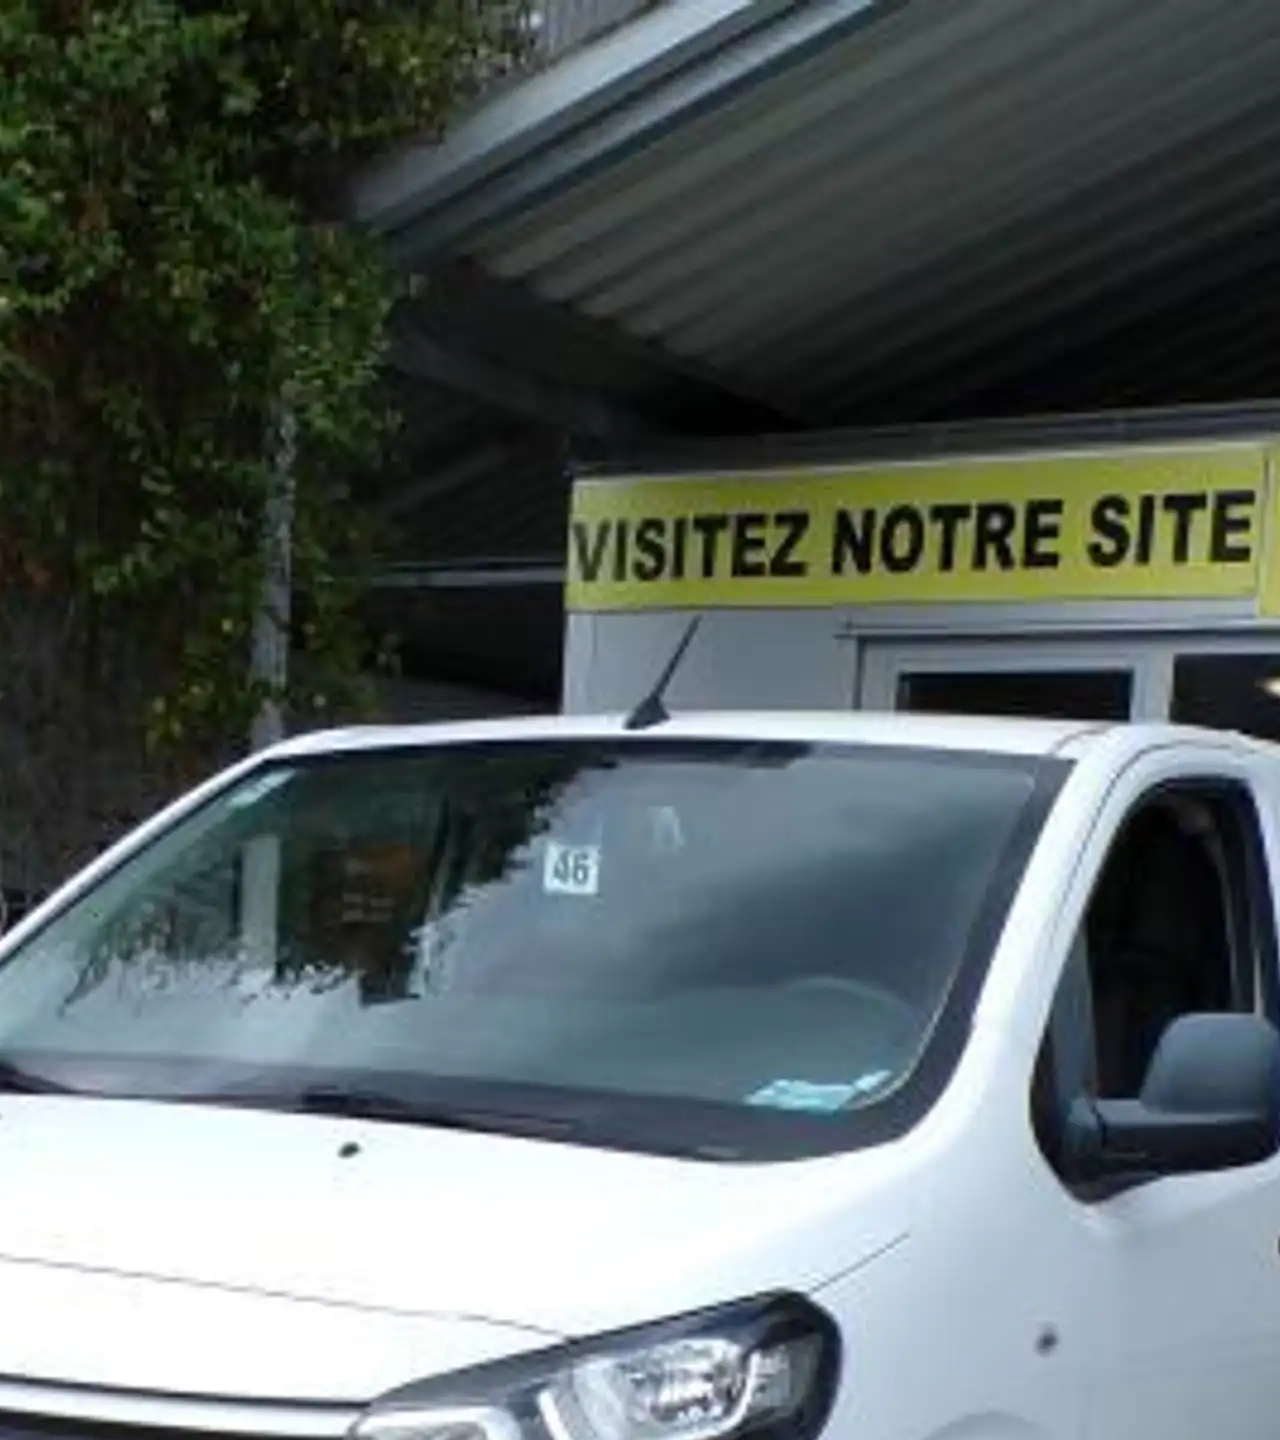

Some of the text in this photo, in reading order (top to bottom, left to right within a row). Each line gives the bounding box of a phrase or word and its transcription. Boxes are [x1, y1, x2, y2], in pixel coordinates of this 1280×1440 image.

[573, 489, 1255, 582] VISITEZ NOTRE SITE
[553, 848, 589, 886] 46
